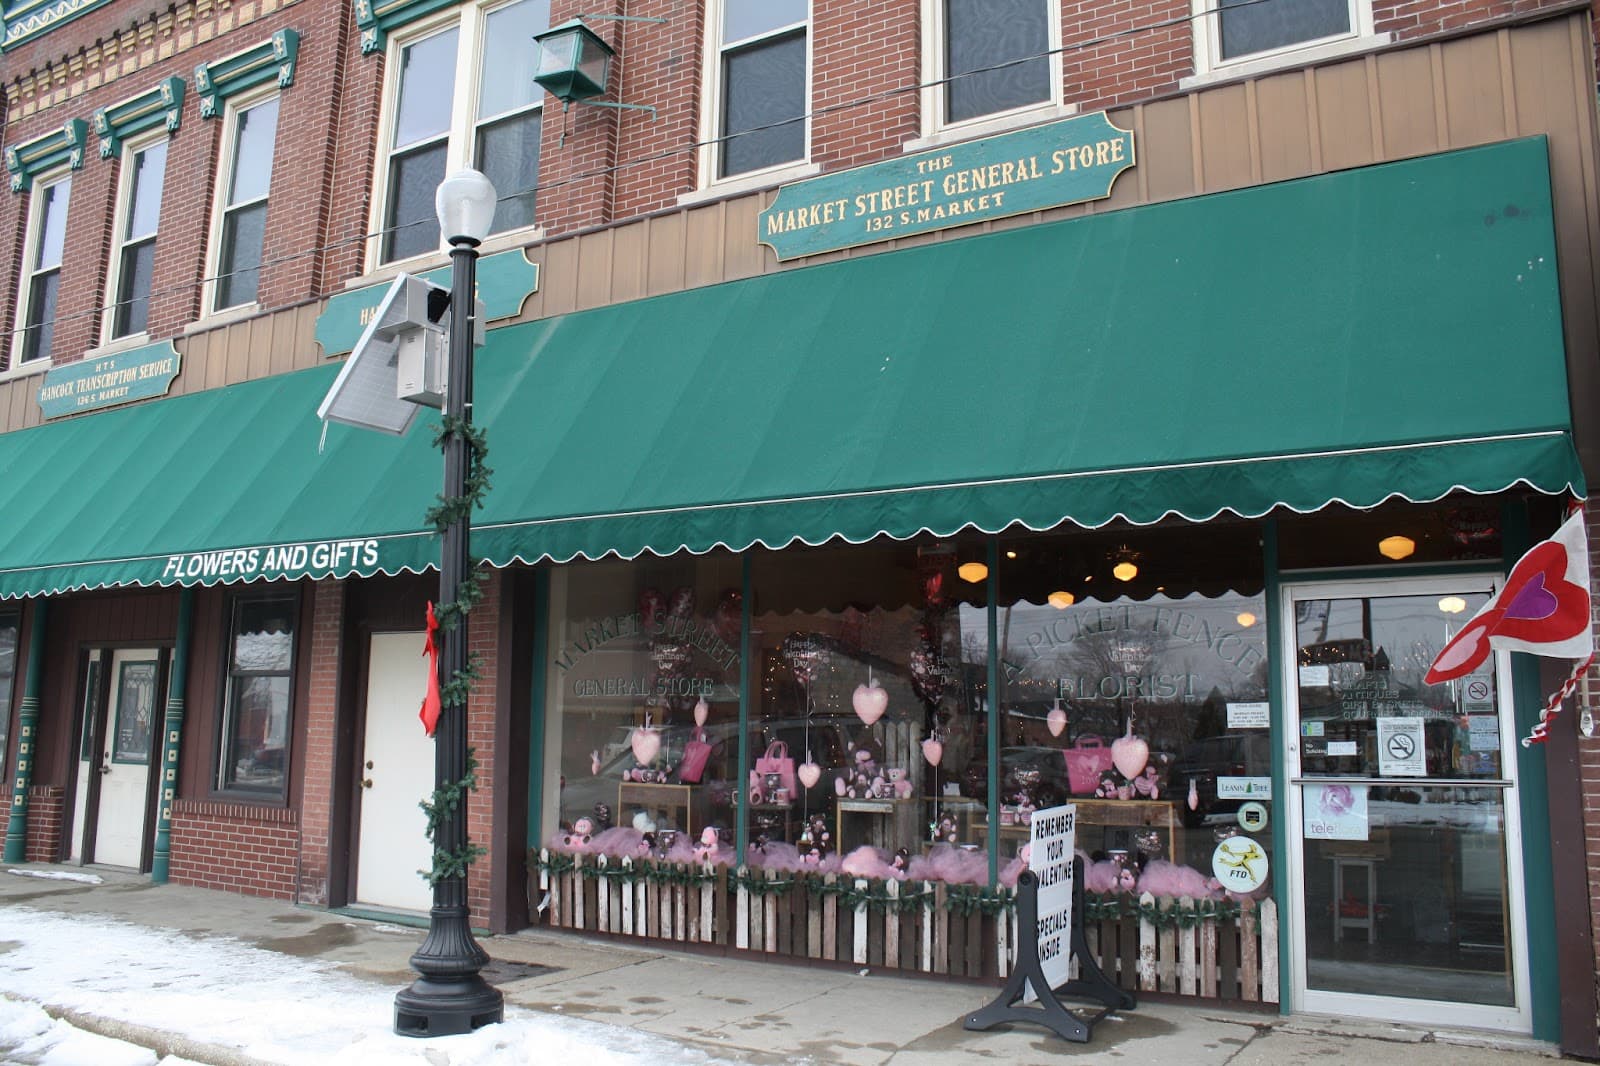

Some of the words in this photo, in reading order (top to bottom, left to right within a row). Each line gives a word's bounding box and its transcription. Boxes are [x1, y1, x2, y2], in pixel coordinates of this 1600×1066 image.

[916, 155, 953, 174] THE
[767, 200, 849, 236] MARKET
[854, 180, 935, 217] STREET
[942, 158, 1043, 196] GENERAL
[1051, 137, 1125, 174] STORE
[866, 216, 894, 232] 132
[41, 381, 75, 401] HANCOCK
[77, 367, 137, 393] TRANSCRIPTION
[138, 358, 173, 379] SERVICE
[99, 386, 130, 401] MARKET
[162, 550, 260, 578] FLOWERS
[261, 544, 308, 571] AND
[311, 540, 379, 568] GIFTS
[554, 613, 641, 676] MARKET
[653, 612, 741, 672] STREET
[1026, 603, 1139, 661] PICKET
[1151, 606, 1264, 678] FENCE
[574, 678, 650, 697] GENERAL
[656, 678, 714, 697] STORE
[1054, 674, 1201, 700] FLORIST
[1035, 813, 1073, 841] REMEMBER
[1046, 839, 1064, 862] YOUR
[1230, 869, 1247, 879] FTD
[1037, 909, 1067, 939] SPECIALS
[1039, 937, 1060, 963] INSIDE
